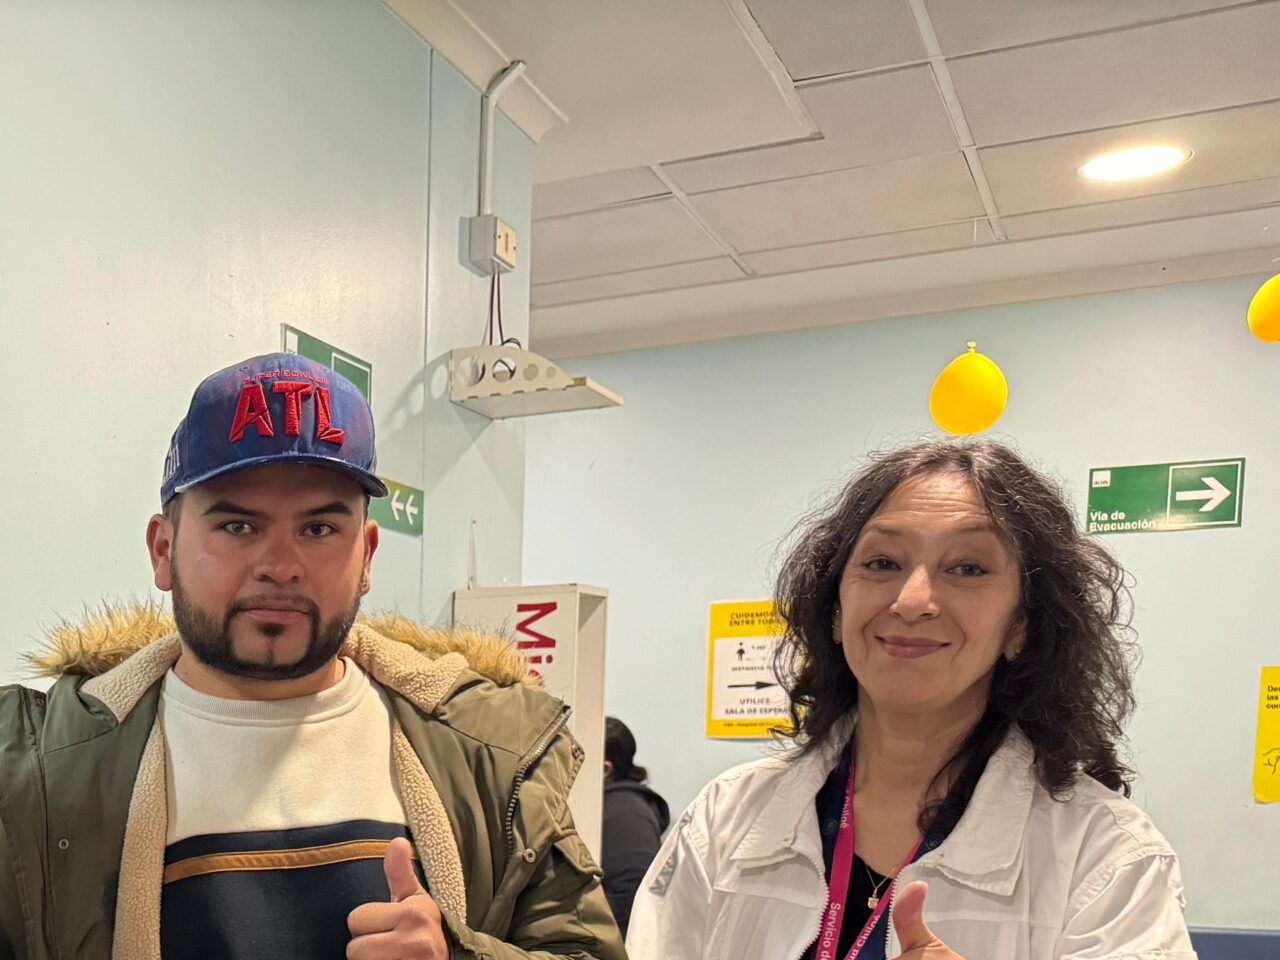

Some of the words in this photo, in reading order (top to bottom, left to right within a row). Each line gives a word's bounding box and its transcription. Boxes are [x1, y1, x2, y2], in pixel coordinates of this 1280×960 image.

[228, 380, 345, 445] ATL
[1111, 510, 1125, 520] de
[822, 902, 841, 948] Servicio
